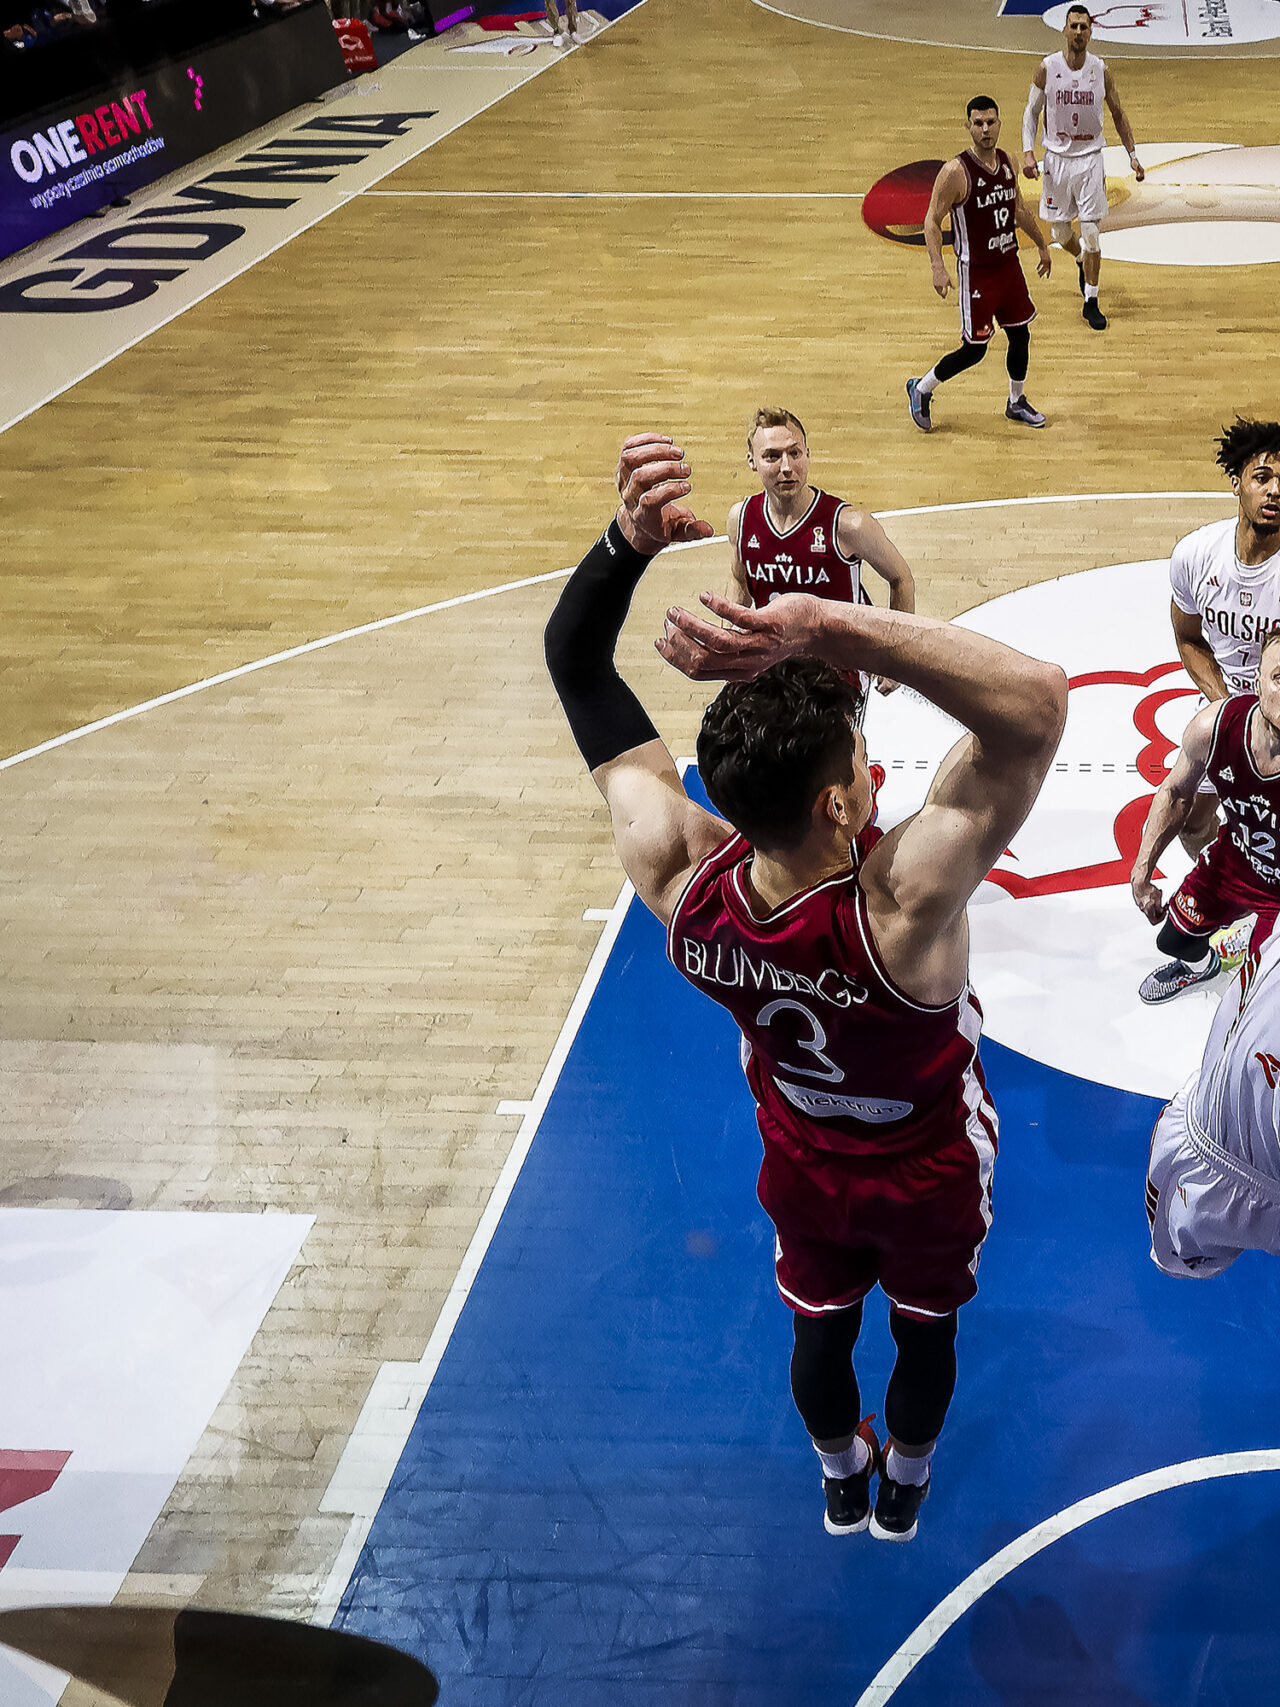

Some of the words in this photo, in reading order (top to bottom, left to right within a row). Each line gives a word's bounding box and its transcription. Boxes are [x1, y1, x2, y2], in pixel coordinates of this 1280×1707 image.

[11, 89, 153, 183] ONERENT
[0, 110, 439, 313] GDYNIA
[993, 207, 1010, 229] 19
[746, 560, 830, 584] LATVIJA
[1237, 649, 1250, 667] 7
[1238, 822, 1276, 861] 12
[683, 937, 868, 1008] BLUMBERGS
[756, 998, 846, 1083] 3
